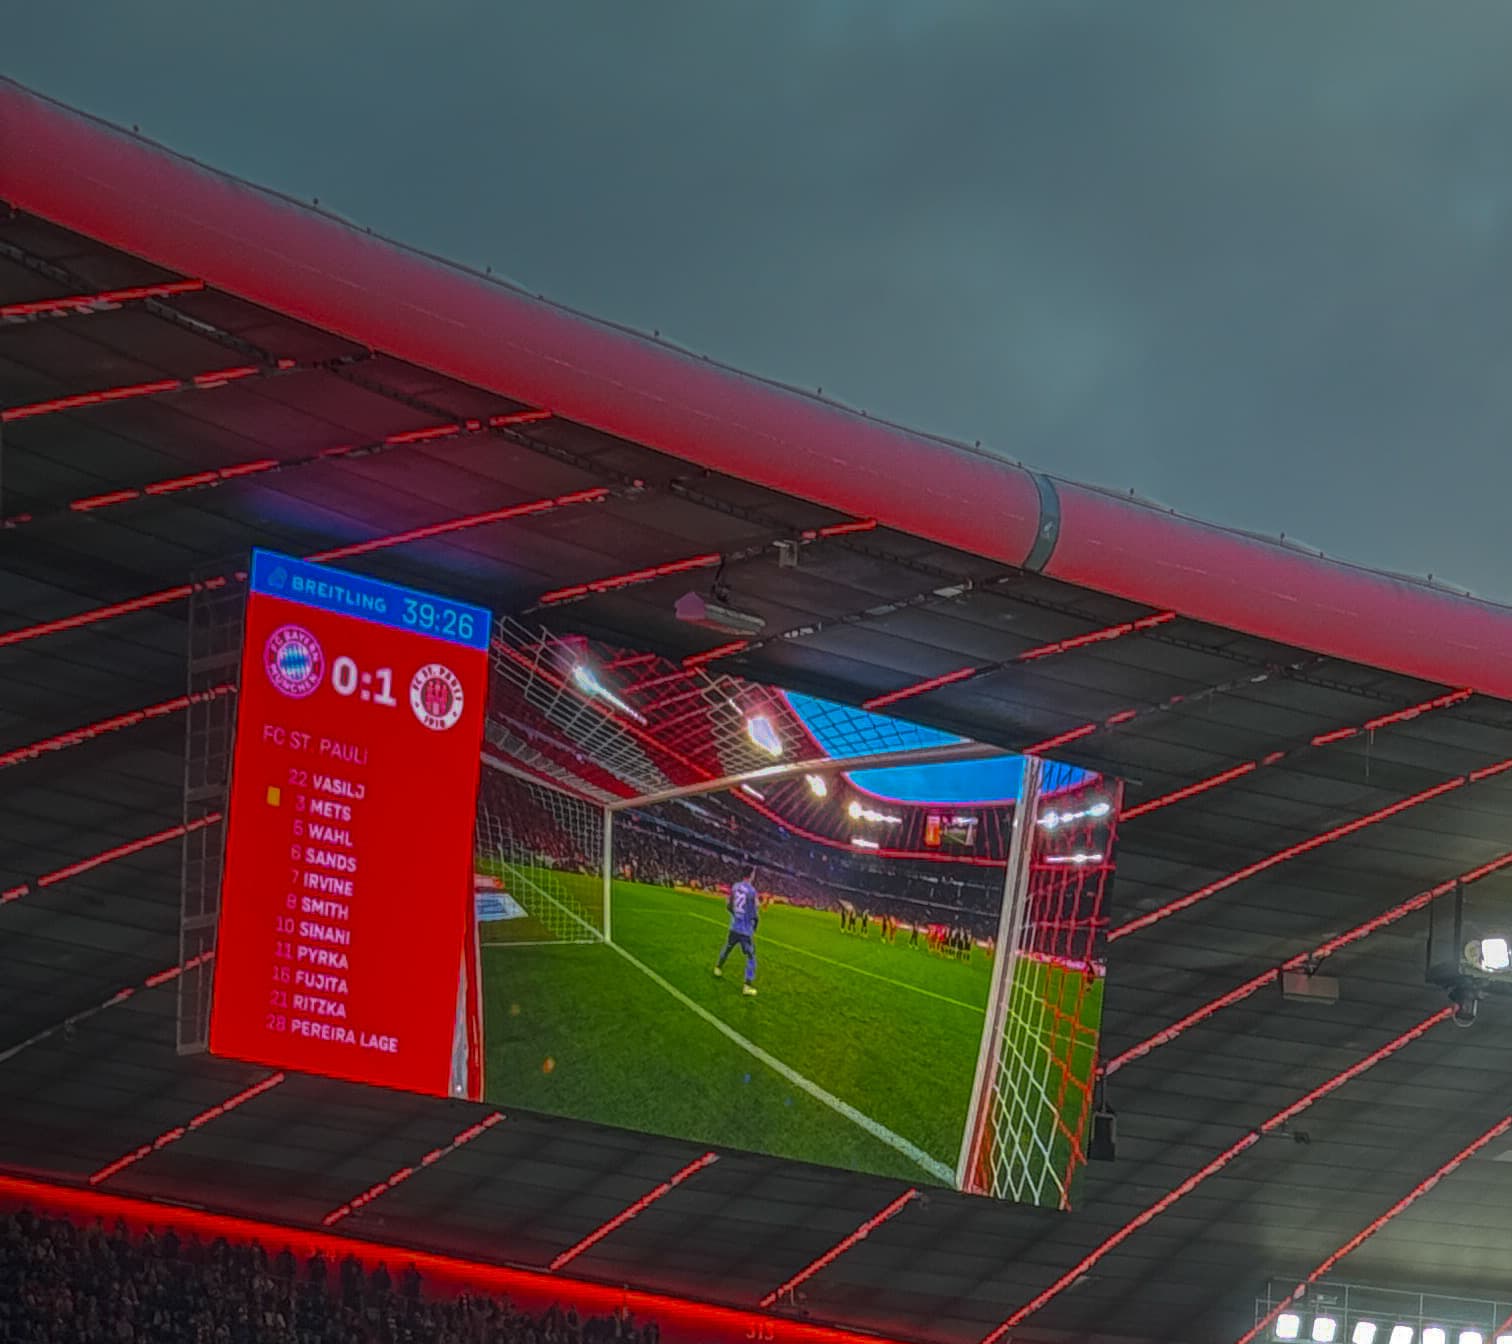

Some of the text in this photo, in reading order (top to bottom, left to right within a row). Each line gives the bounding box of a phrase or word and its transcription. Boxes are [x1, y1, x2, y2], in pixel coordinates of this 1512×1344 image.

[291, 576, 474, 640] BREITLING 39:26
[331, 655, 398, 708] 0:1
[263, 724, 286, 746] FC
[320, 738, 369, 766] PAULI
[313, 773, 366, 800] VASILJ
[309, 798, 352, 822] METS
[308, 823, 353, 847] WAHL
[305, 847, 357, 873] SANDS
[303, 872, 354, 897] IRVINE
[301, 896, 349, 920] SMITH
[299, 921, 351, 945] SINANI
[297, 944, 349, 970] PYRKA
[295, 970, 349, 995] FUJITA
[292, 994, 347, 1018] RITZKA
[291, 1018, 357, 1044] PEREIRA
[359, 1031, 399, 1053] LAGE
